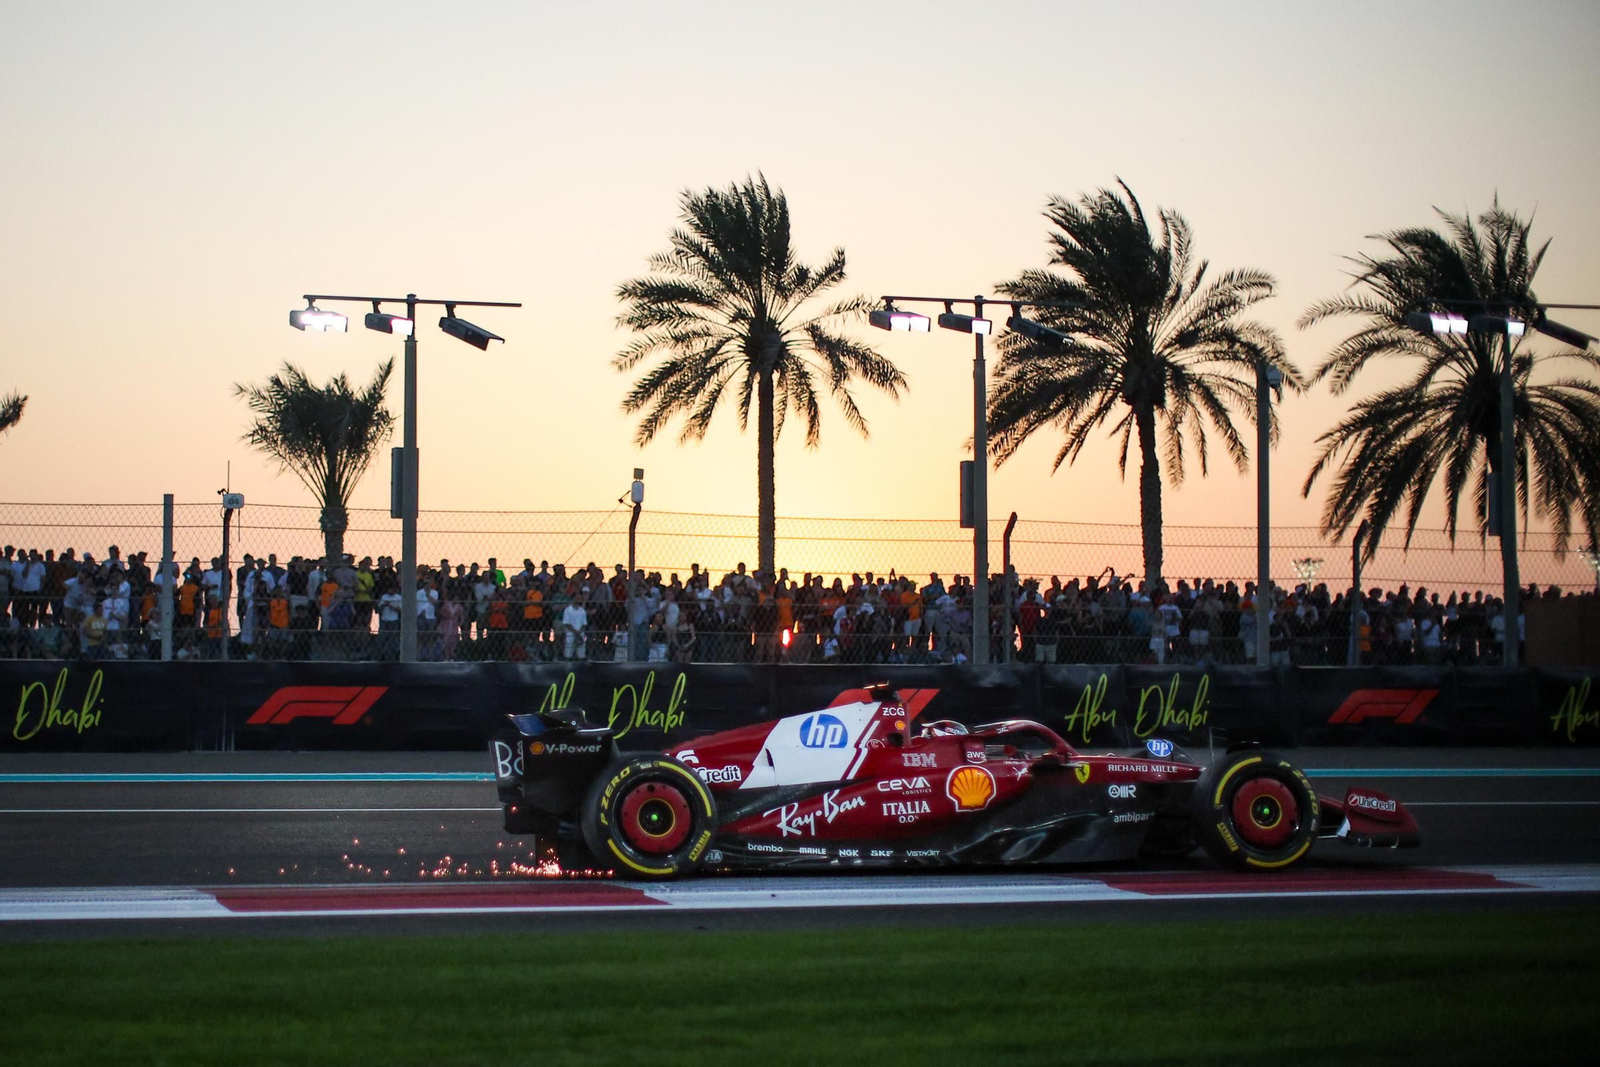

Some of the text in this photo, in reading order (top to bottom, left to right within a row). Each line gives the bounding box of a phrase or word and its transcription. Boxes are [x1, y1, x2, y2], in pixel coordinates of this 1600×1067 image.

[13, 668, 104, 740] Dhabi
[246, 686, 389, 724] F1
[608, 671, 687, 739] Dhabi
[882, 707, 905, 716] ZCG
[1065, 672, 1210, 743] Abu Dhabi
[1327, 689, 1440, 724] F1
[1550, 676, 1600, 742] Abu
[807, 714, 844, 748] hp
[545, 744, 602, 753] V-Power
[966, 750, 986, 758] aws
[1152, 740, 1169, 756] hp
[902, 753, 937, 767] IBM
[1108, 764, 1148, 772] RICHARD
[695, 766, 741, 783] Credit
[601, 766, 631, 810] ZERO
[882, 800, 931, 816] ITALIA
[1358, 795, 1396, 812] UniCredit
[1113, 812, 1151, 823] ambipar
[747, 843, 783, 853] brembo
[799, 847, 827, 855] MAHLE
[839, 849, 859, 857] NGK
